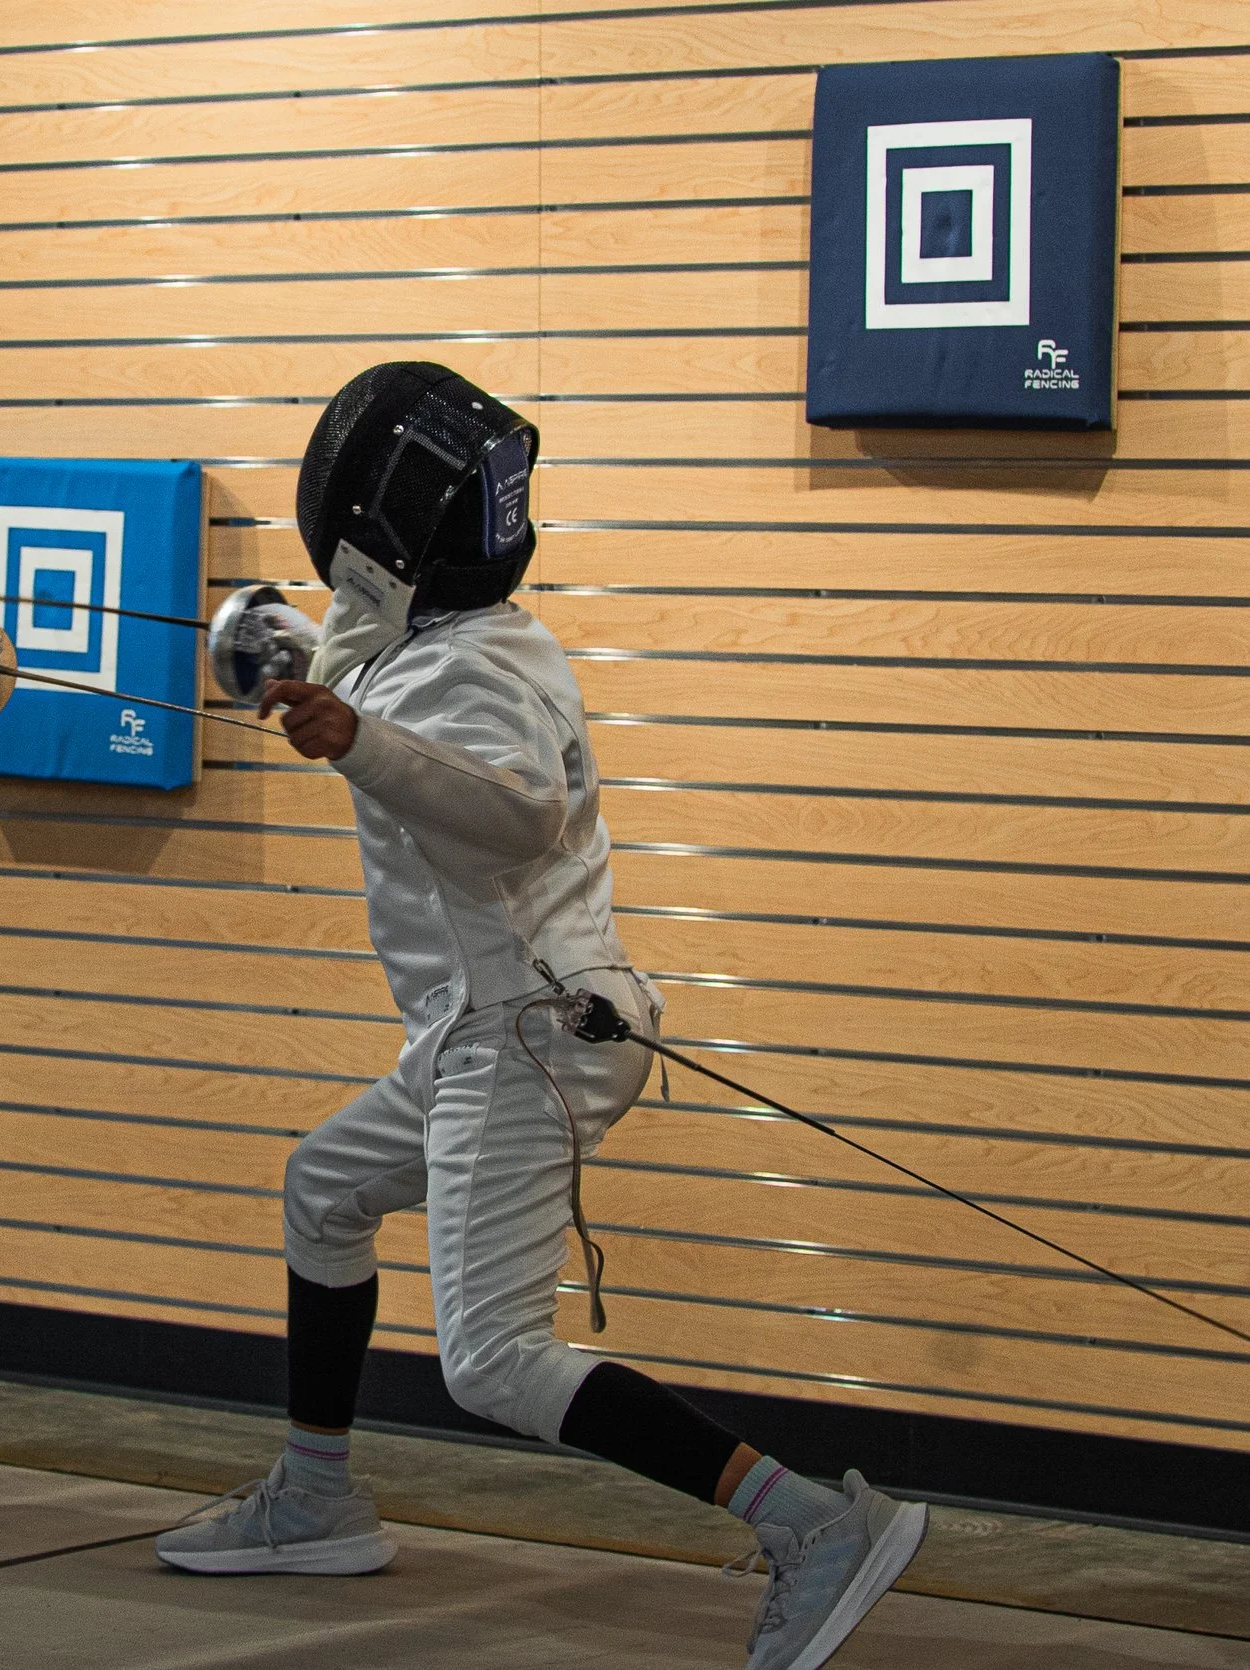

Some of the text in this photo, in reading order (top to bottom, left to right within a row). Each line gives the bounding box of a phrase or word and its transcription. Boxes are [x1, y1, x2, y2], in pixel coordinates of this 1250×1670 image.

[1024, 369, 1080, 379] RADICAL
[1024, 379, 1080, 389] FENCING
[110, 734, 154, 746] RADICAL
[110, 743, 154, 756] FENCING
